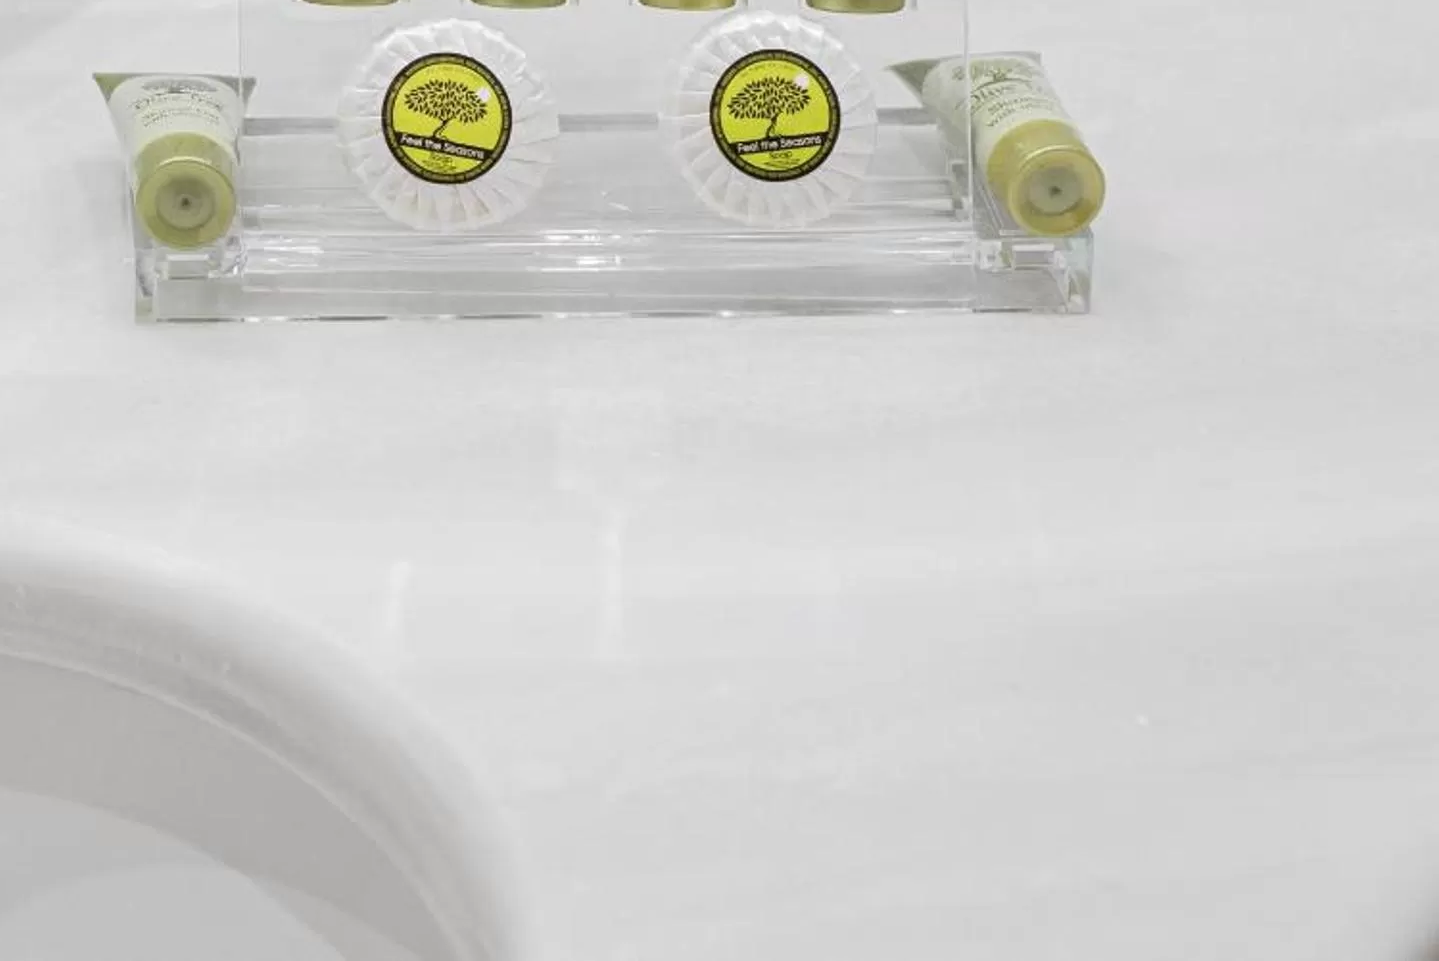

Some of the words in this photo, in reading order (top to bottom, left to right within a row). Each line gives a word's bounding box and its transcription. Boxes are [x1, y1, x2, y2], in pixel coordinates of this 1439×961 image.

[400, 133, 423, 147] Feel
[424, 139, 442, 151] the
[443, 142, 485, 159] Seasons
[737, 140, 760, 154] Feel
[779, 135, 822, 149] Seasons
